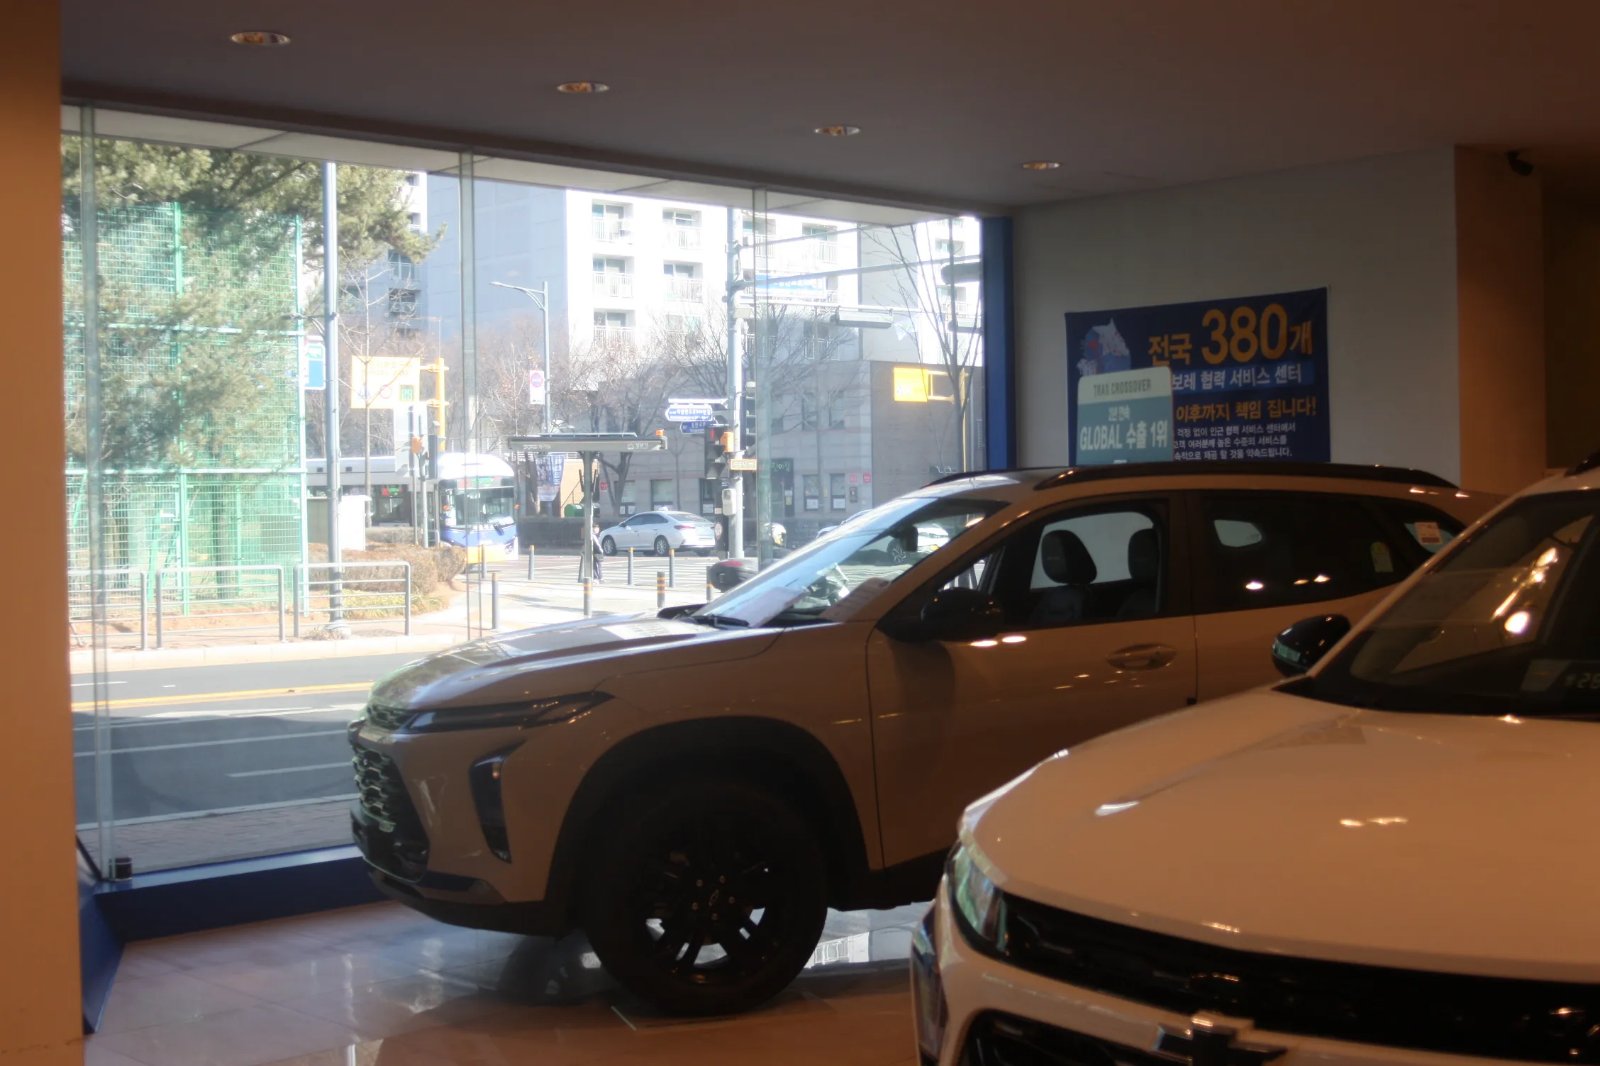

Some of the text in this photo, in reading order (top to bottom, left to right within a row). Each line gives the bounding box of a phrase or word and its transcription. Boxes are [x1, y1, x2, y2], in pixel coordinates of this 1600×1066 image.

[1148, 303, 1312, 367] 전국 380개
[1111, 378, 1152, 395] CROSSOVER
[1172, 363, 1302, 391] 보레 협력 서비스 센터
[1176, 396, 1317, 422] 이후까지 책임 집니다!
[1080, 419, 1168, 451] GLOBAL 수출 1위
[1242, 424, 1264, 435] 서비스
[1174, 452, 1201, 461] 속적으로
